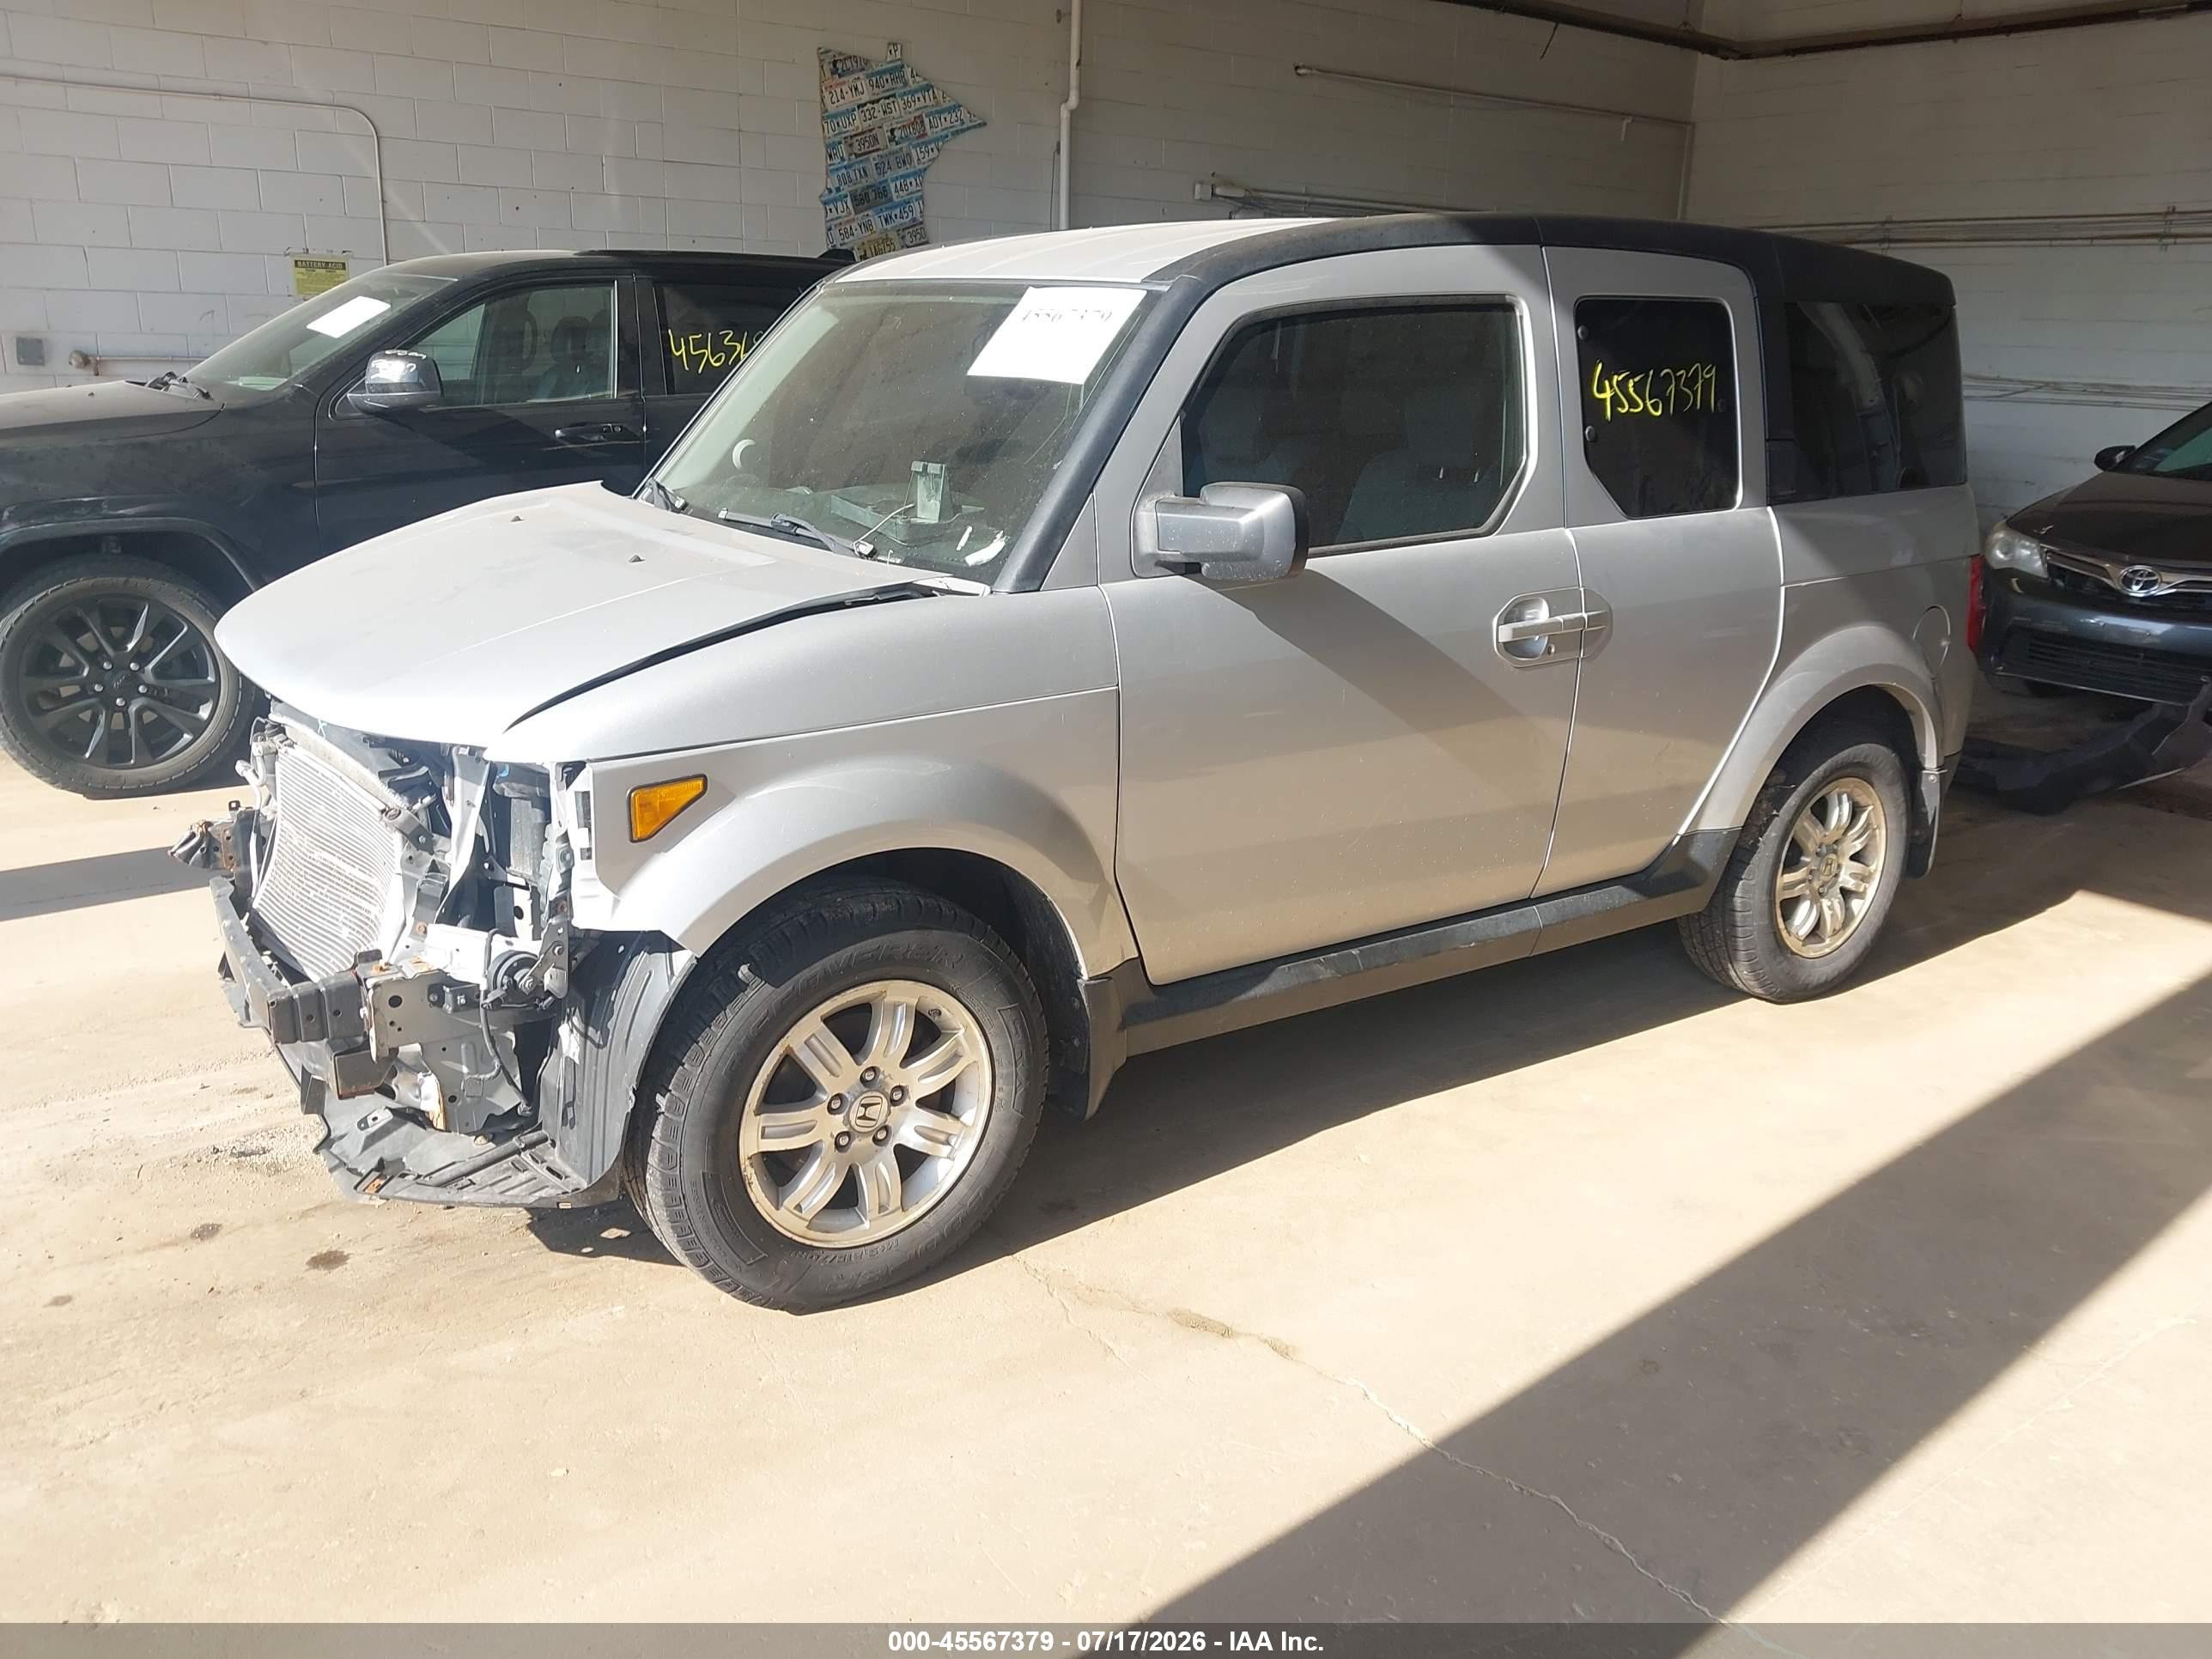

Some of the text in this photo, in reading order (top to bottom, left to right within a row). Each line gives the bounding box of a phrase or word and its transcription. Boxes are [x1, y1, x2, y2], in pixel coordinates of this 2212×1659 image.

[874, 159, 892, 178] 524
[328, 261, 343, 270] ACID
[1593, 358, 1717, 422] 45567379
